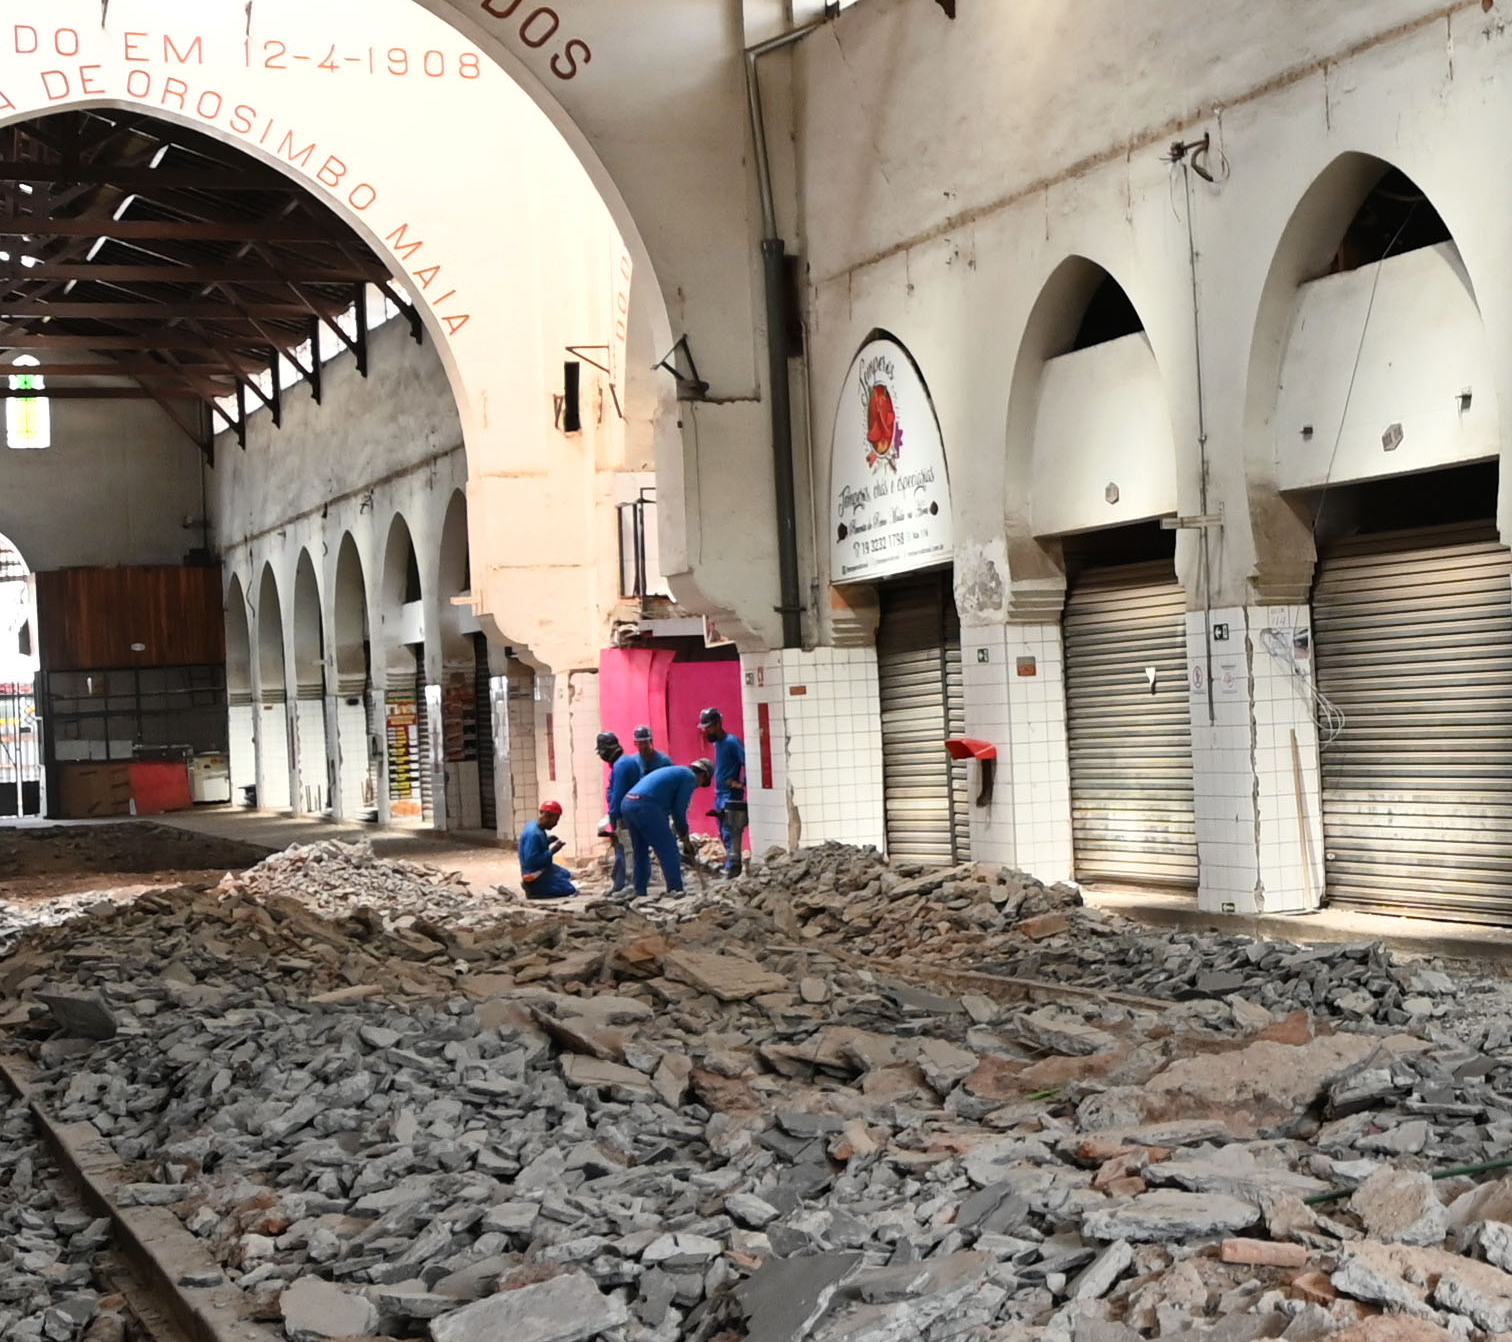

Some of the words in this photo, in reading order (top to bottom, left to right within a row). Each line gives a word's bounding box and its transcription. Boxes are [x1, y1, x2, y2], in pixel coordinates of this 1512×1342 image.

[123, 31, 203, 65] EM
[243, 37, 481, 80] 12-4-1908
[40, 63, 107, 102] DE
[126, 69, 377, 211] OROSIMBO
[385, 222, 471, 337] MAIA
